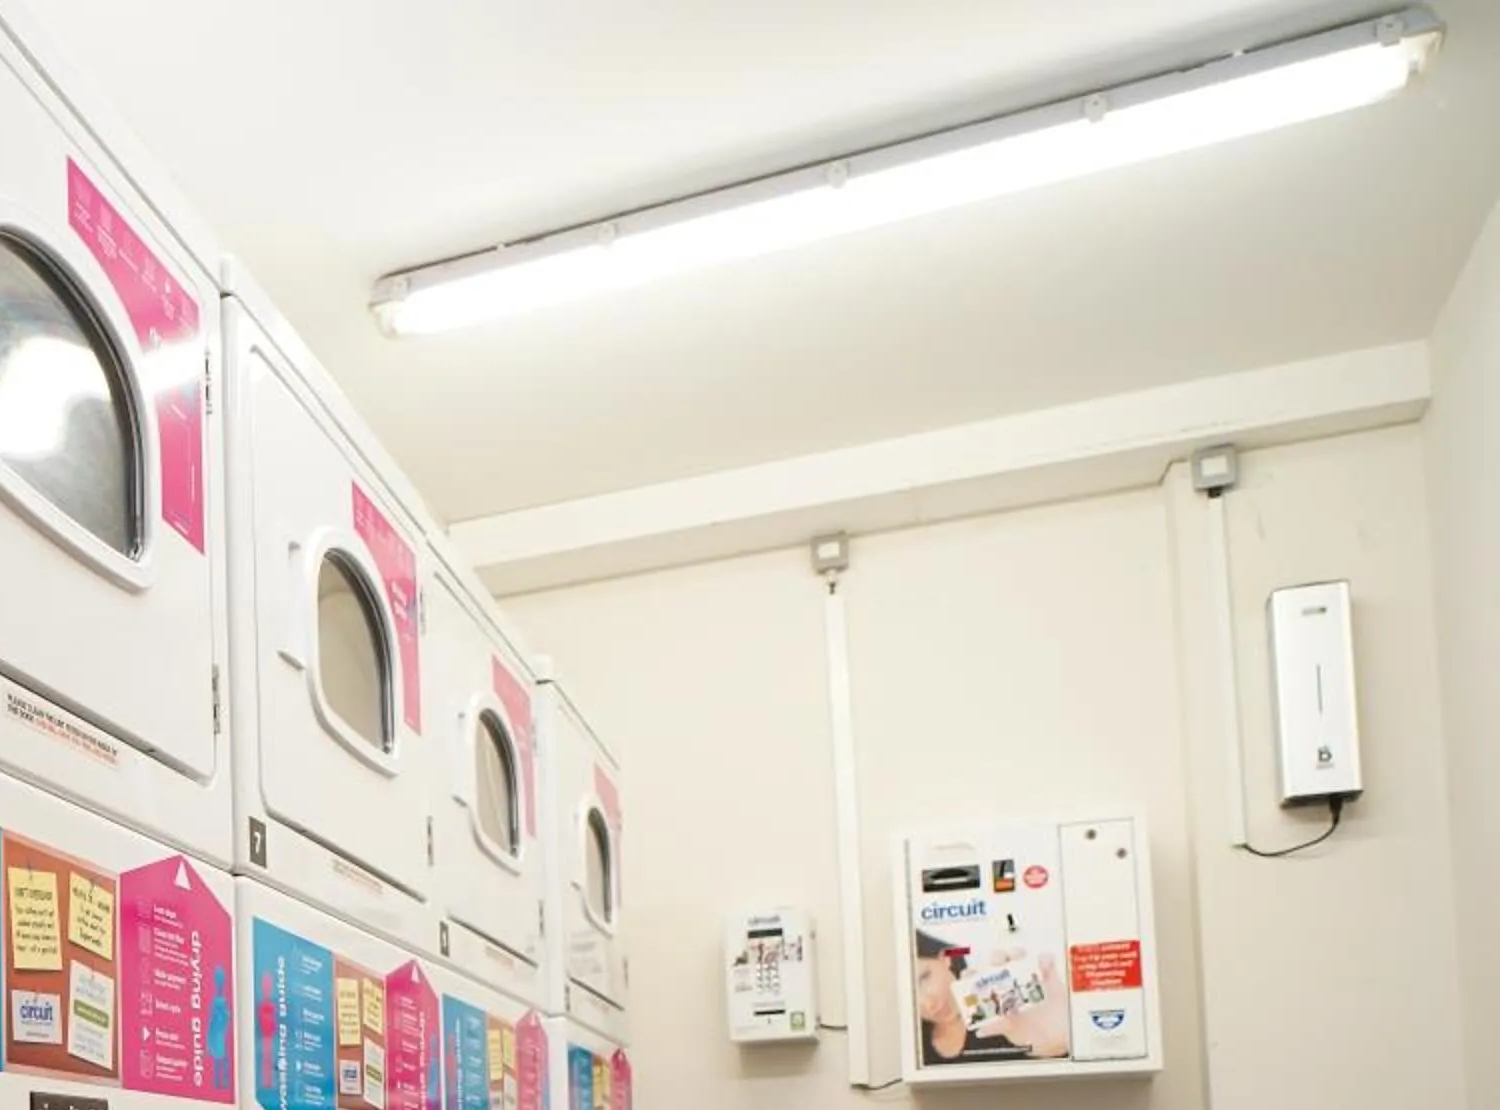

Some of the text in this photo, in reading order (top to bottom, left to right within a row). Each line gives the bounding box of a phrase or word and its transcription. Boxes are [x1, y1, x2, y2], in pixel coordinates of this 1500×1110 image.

[920, 900, 987, 921] circuit
[20, 999, 53, 1021] circuit
[190, 929, 204, 1088] drying guide
